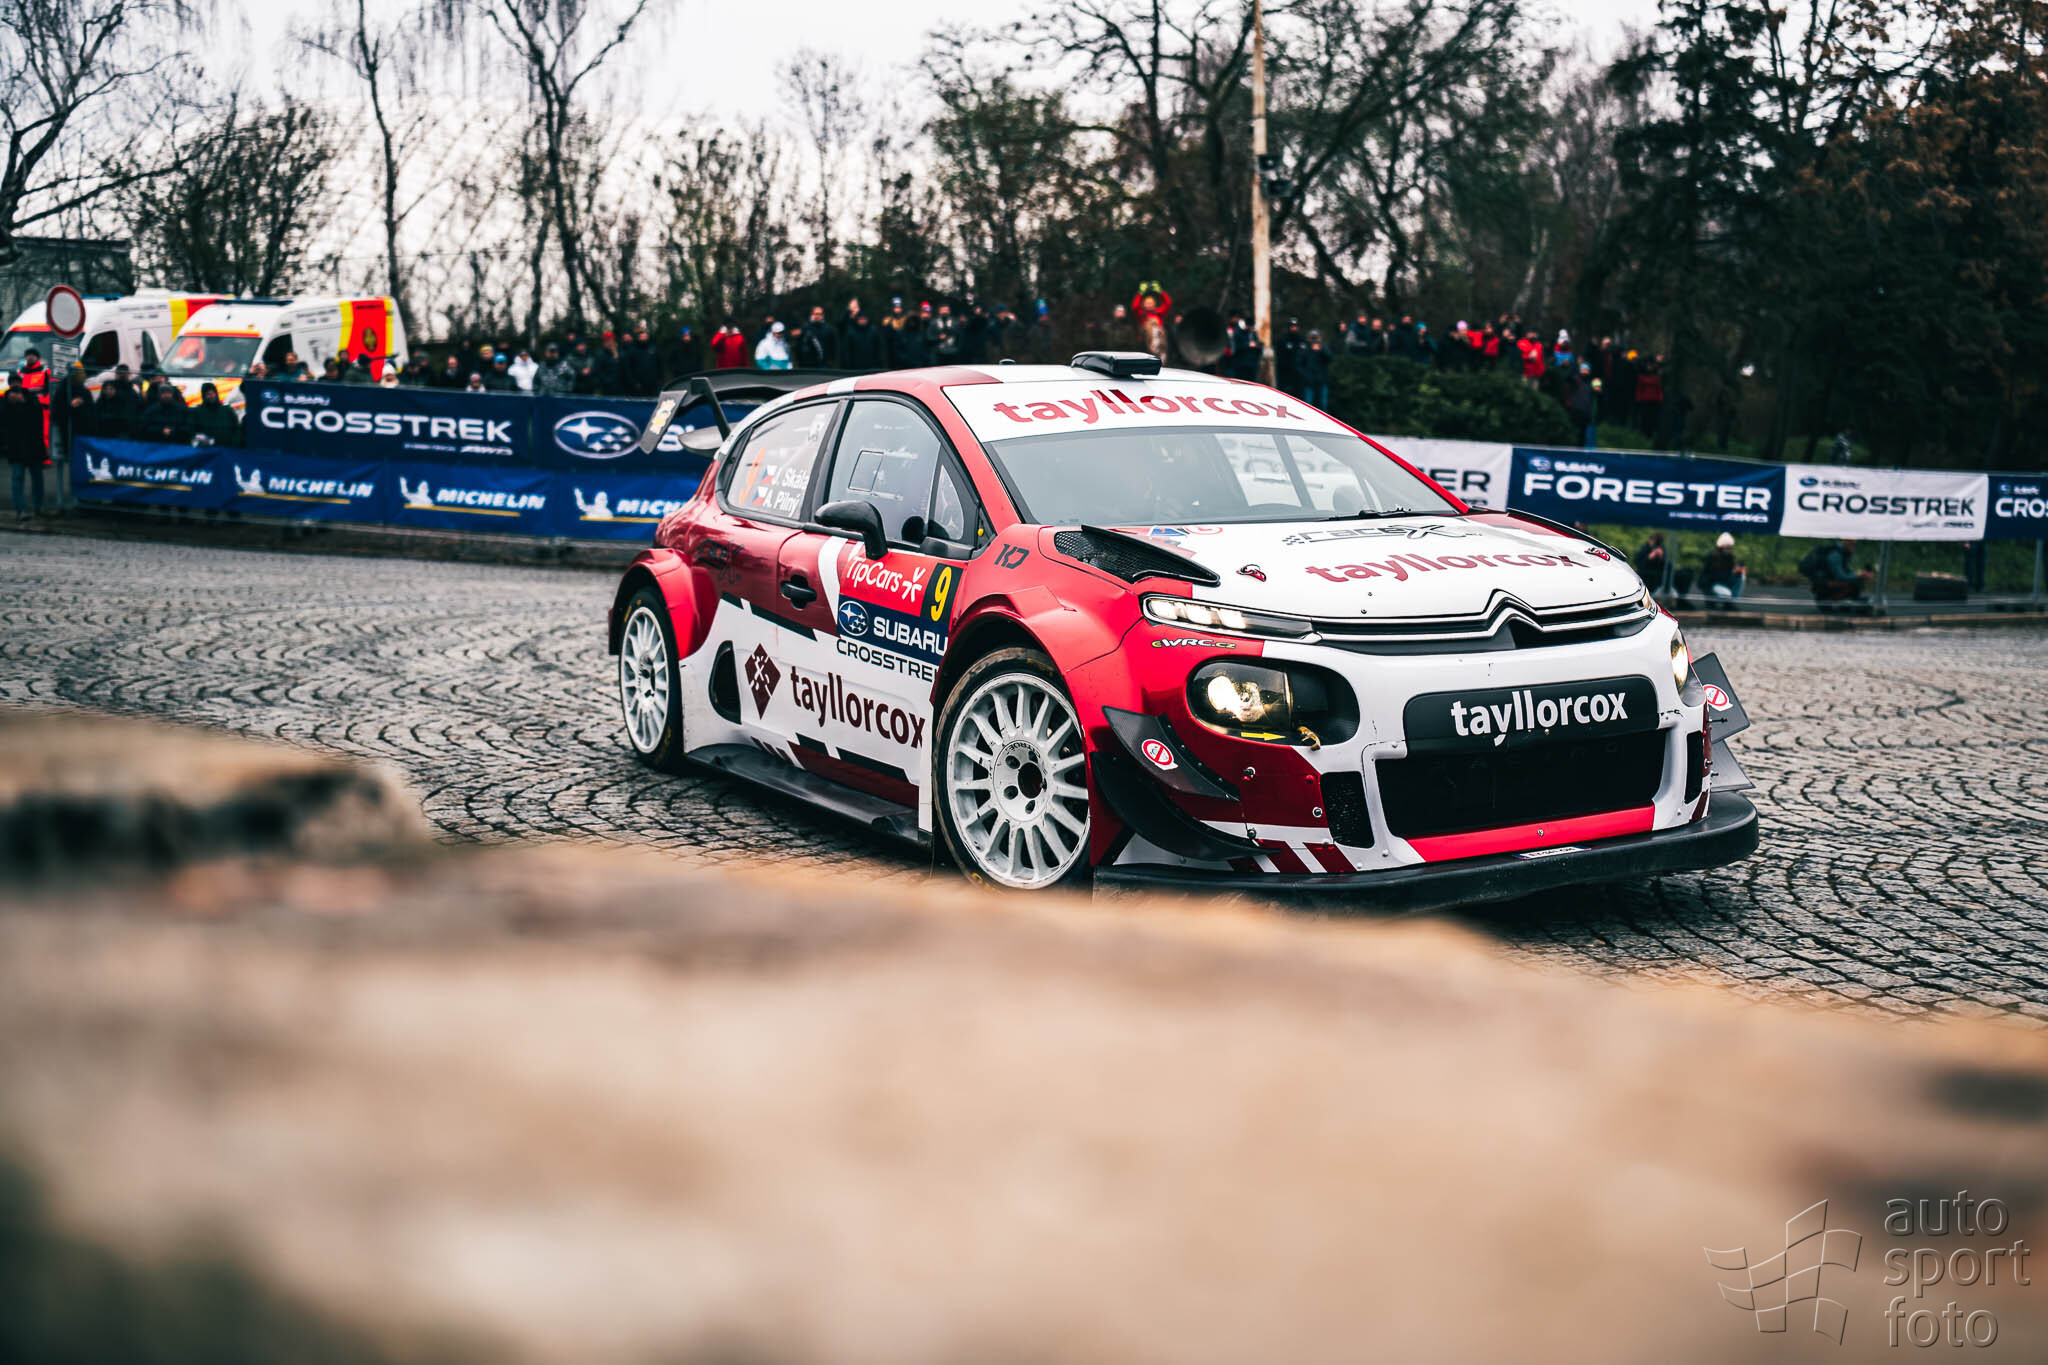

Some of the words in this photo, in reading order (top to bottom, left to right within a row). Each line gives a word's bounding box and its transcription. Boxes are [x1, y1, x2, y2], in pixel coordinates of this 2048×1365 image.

[993, 389, 1305, 424] tayllorcox
[260, 406, 512, 443] CROSSTREK
[117, 465, 214, 485] MICHELIN
[268, 477, 375, 498] MICHELIN
[1417, 466, 1491, 492] ER
[1523, 472, 1772, 511] FORESTER
[436, 489, 546, 510] MICHELIN
[616, 499, 686, 515] MICH
[1797, 491, 1976, 517] CROSSTREK
[1995, 497, 2048, 518] CRO
[846, 556, 904, 593] TipCars
[1306, 551, 1591, 582] tayllorcox
[930, 566, 952, 622] 9
[873, 616, 949, 657] SUBARU
[836, 639, 938, 683] CROSSTRE
[790, 665, 926, 749] tayllorcox
[1451, 689, 1629, 747] tayllorcox
